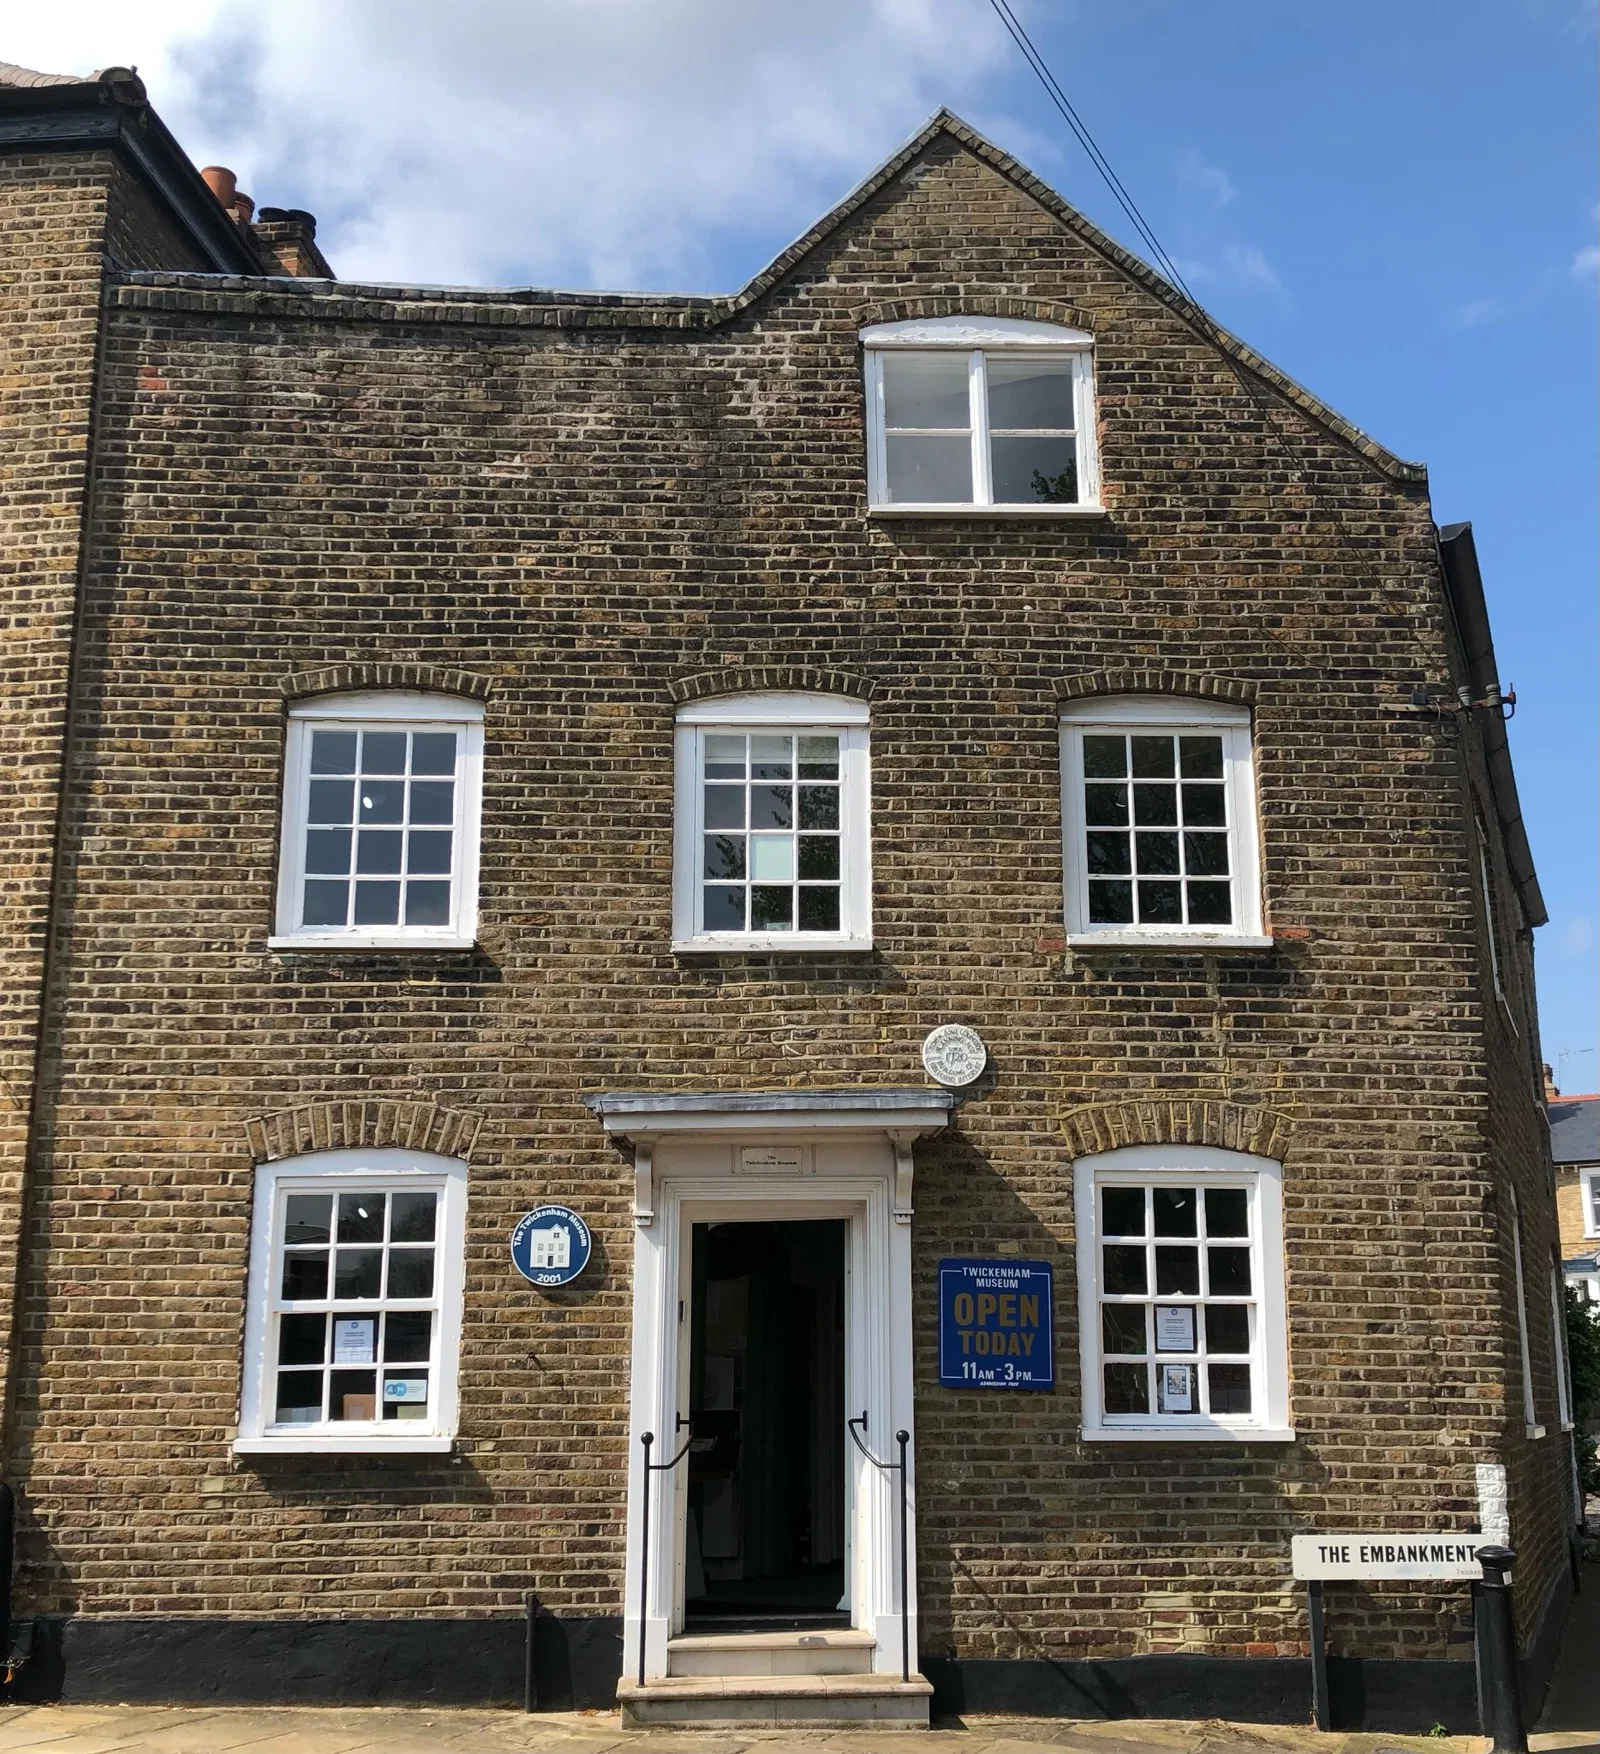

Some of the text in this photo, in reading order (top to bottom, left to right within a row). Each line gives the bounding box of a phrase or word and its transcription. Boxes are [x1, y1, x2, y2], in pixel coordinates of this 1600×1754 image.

[945, 1052, 968, 1067] 1720
[929, 1061, 983, 1084] HISTORIC INTEREST
[936, 1060, 966, 1076] BUILDING
[513, 1208, 588, 1247] The Twickenham Museum
[536, 1273, 562, 1283] 2001
[962, 1267, 1031, 1278] TWICKENHAM
[976, 1278, 1019, 1288] MUSEUM
[953, 1292, 1039, 1328] OPEN
[957, 1330, 1036, 1356] TODAY
[1317, 1544, 1477, 1563] THE EMBANKMENT
[1456, 1568, 1482, 1576] Twicken
